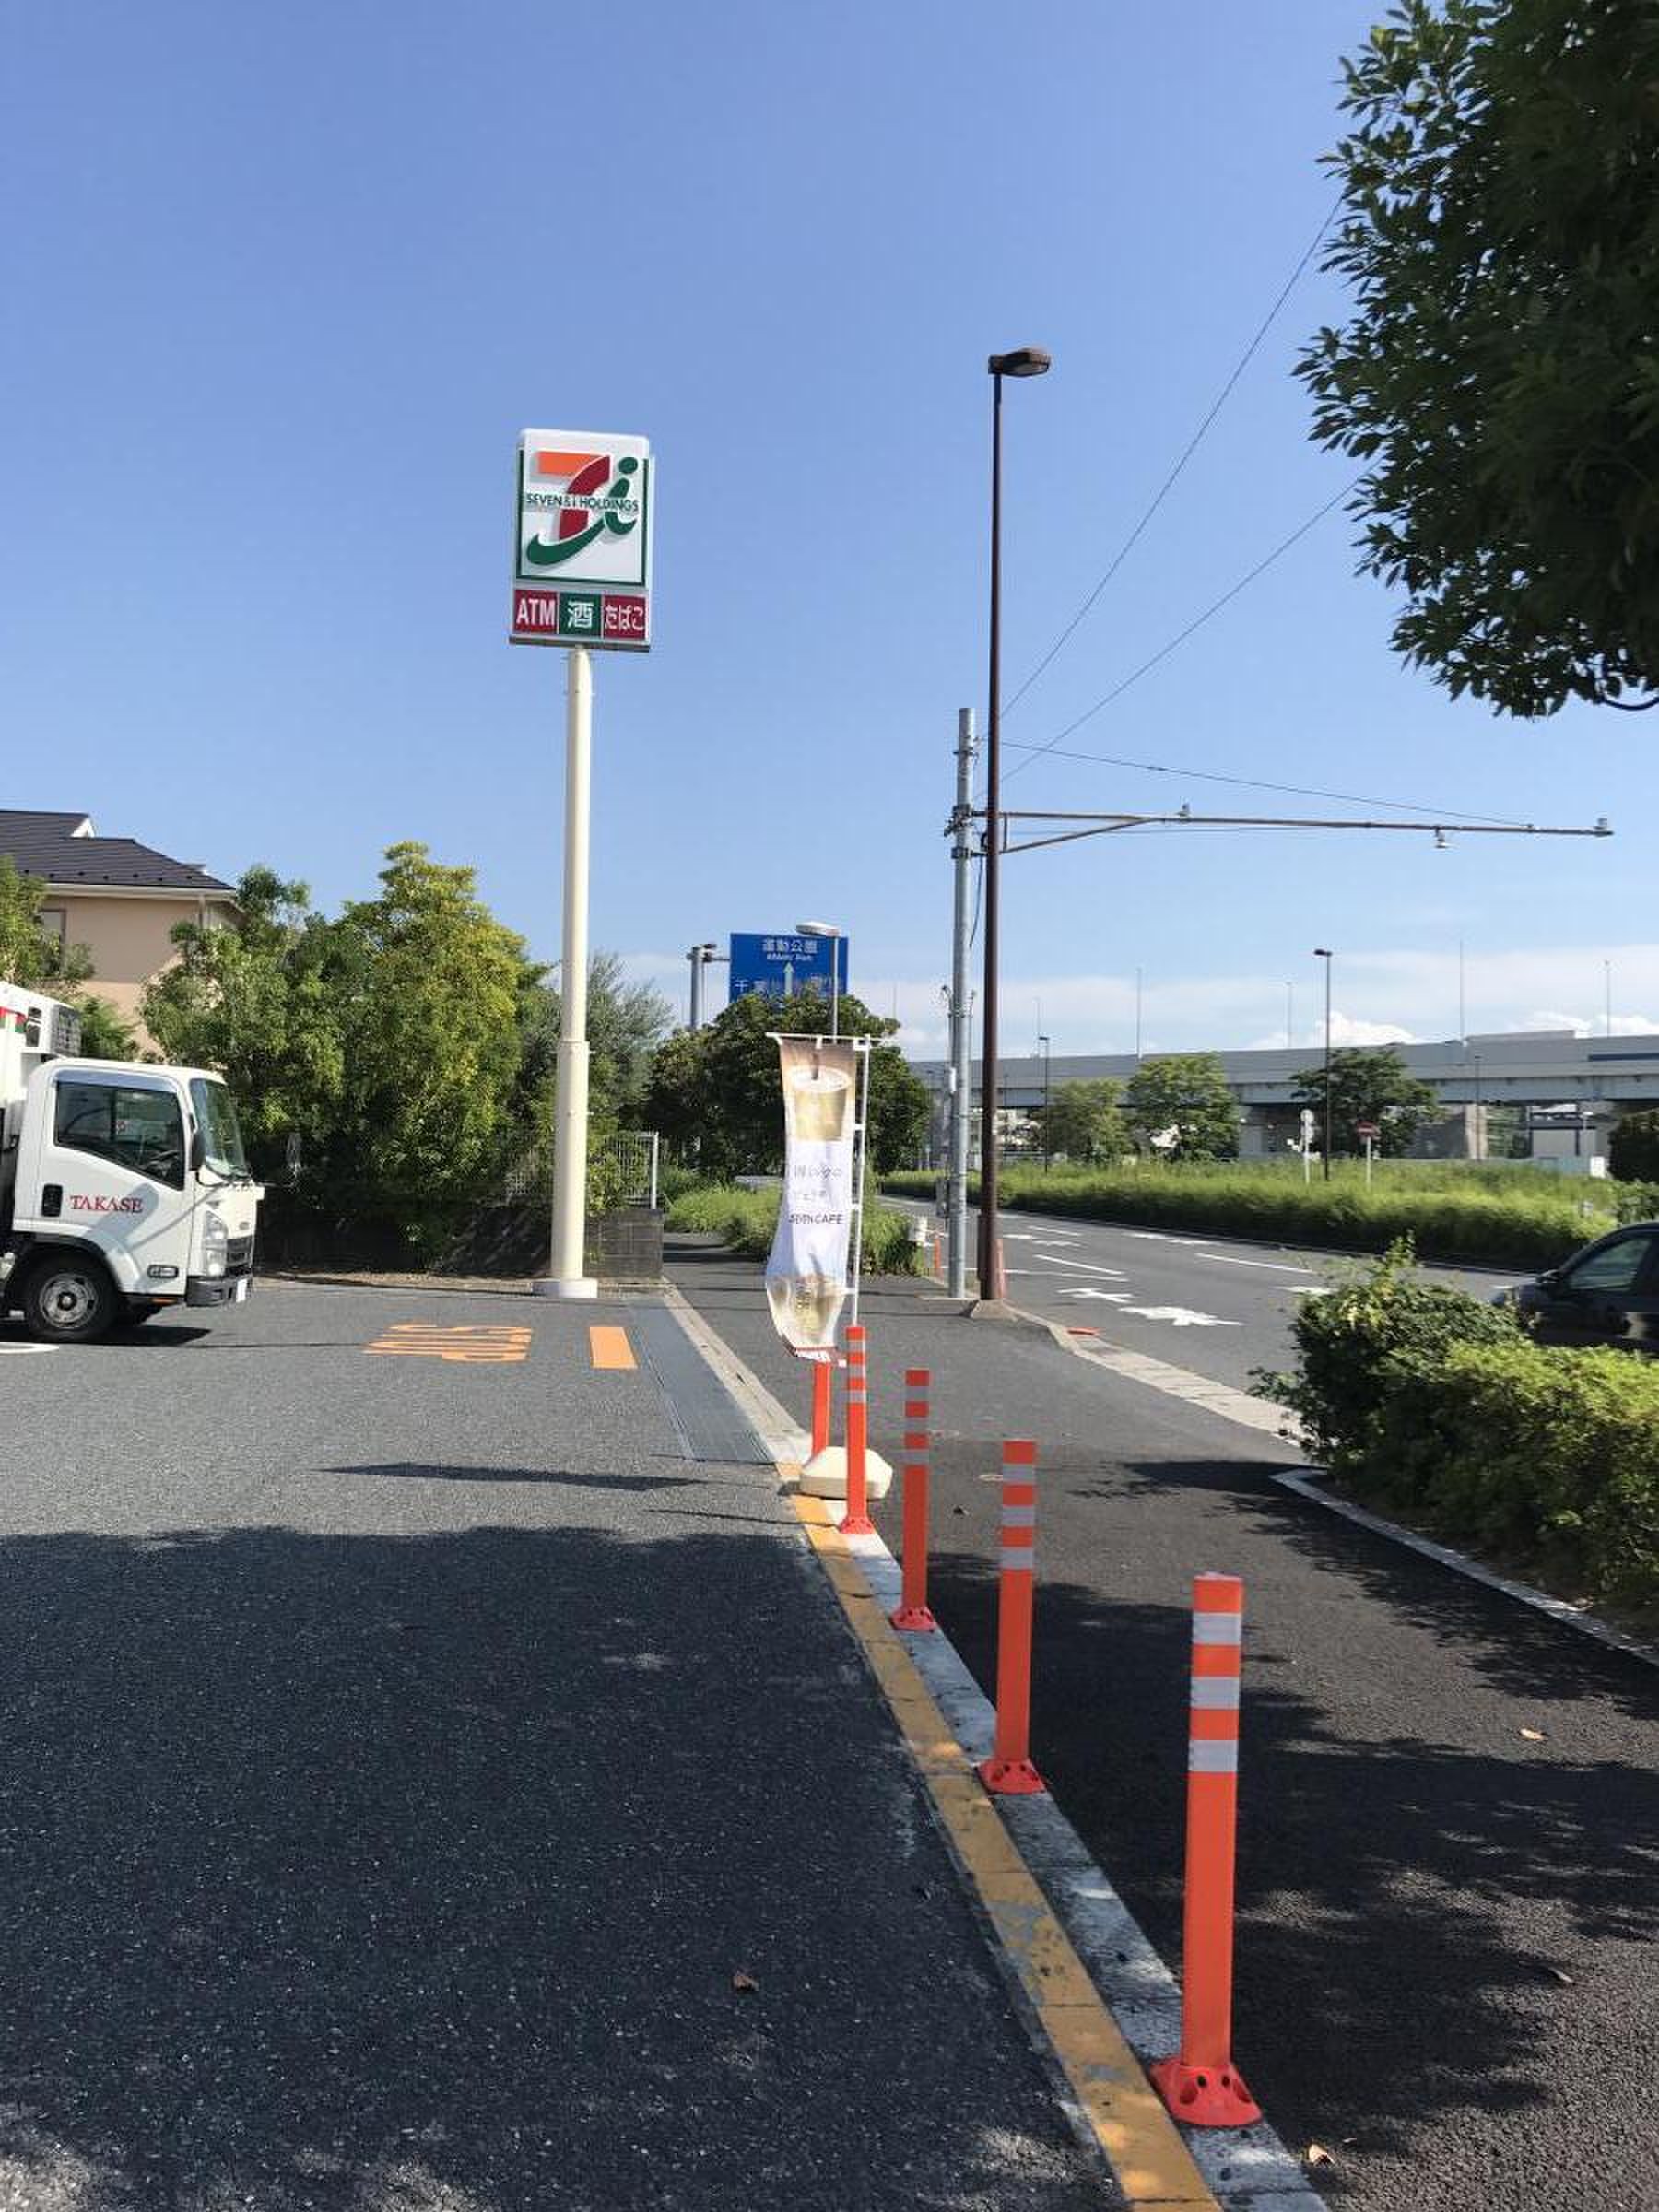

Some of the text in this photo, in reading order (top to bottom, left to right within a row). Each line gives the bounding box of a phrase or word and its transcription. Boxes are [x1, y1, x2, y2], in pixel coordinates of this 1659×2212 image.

[516, 597, 556, 626] ATM
[567, 601, 594, 629] 酒
[604, 604, 644, 630] たばこ
[69, 1195, 143, 1213] TAKASE
